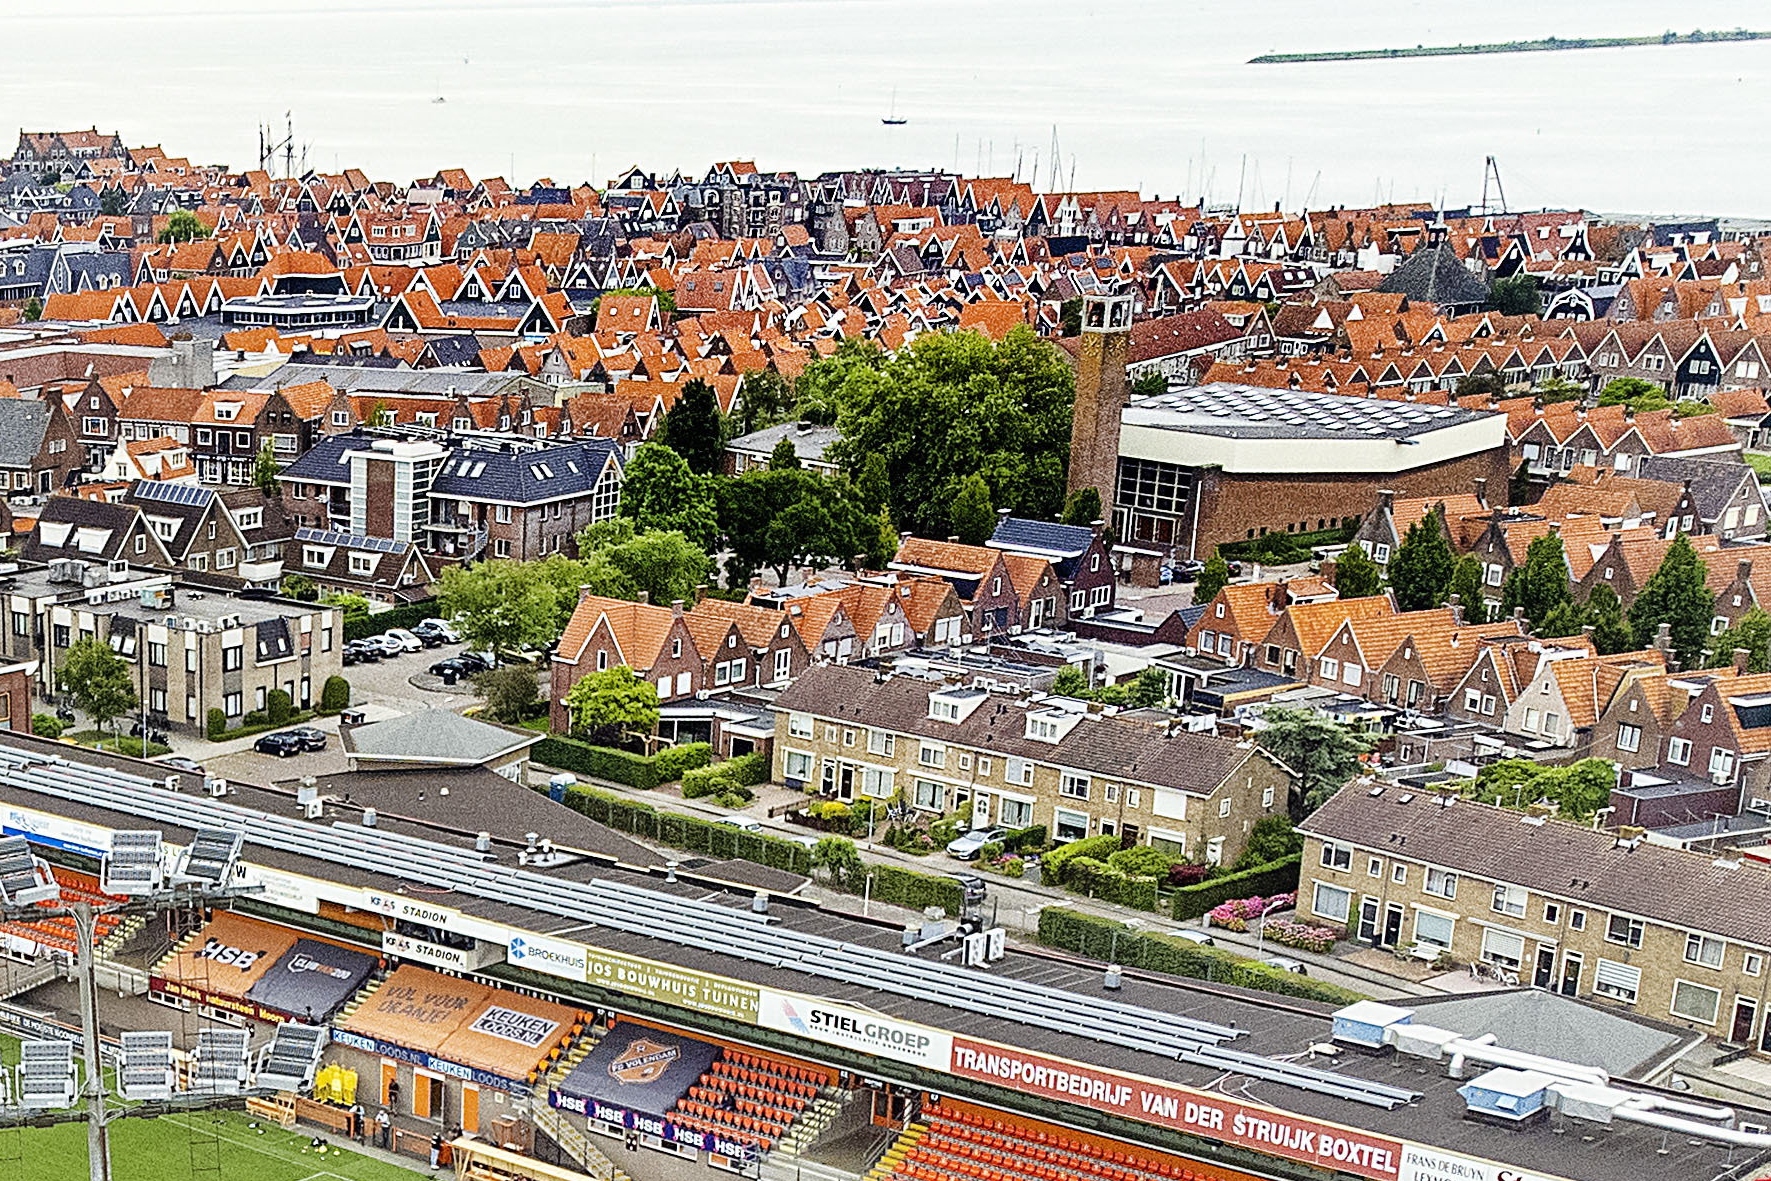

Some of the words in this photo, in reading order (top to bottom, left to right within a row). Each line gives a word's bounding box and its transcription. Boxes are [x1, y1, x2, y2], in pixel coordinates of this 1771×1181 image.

[402, 904, 447, 924] STADION
[202, 941, 259, 968] HSB
[416, 944, 461, 963] STADION
[528, 947, 585, 969] BROEKHUIS
[165, 981, 180, 995] Jan
[587, 960, 612, 976] JOS
[617, 968, 697, 998] BOUWHUIS
[702, 988, 758, 1013] TUINEN
[486, 1007, 554, 1034] KEUKEN
[810, 1009, 862, 1035] STIEL
[864, 1023, 930, 1050] GROEP
[333, 1031, 374, 1051] KEUKEN
[375, 1040, 423, 1065] LOODS.NL
[428, 1058, 472, 1080] KEUKEN
[626, 1048, 678, 1068] VOLENDAM
[557, 1094, 585, 1112] HSB
[595, 1105, 624, 1123] HSB
[634, 1116, 664, 1134] HSB
[674, 1128, 704, 1147] HSB
[955, 1047, 1132, 1106] TRANSPORTBEDRIJF
[1141, 1091, 1178, 1120] VAN
[1185, 1101, 1224, 1131] DER
[1232, 1114, 1316, 1153] STRUIJK
[1318, 1134, 1397, 1173] BOXTEL
[1406, 1152, 1436, 1170] FRANS
[1438, 1160, 1450, 1173] DE
[1451, 1163, 1484, 1181] BRUYN
